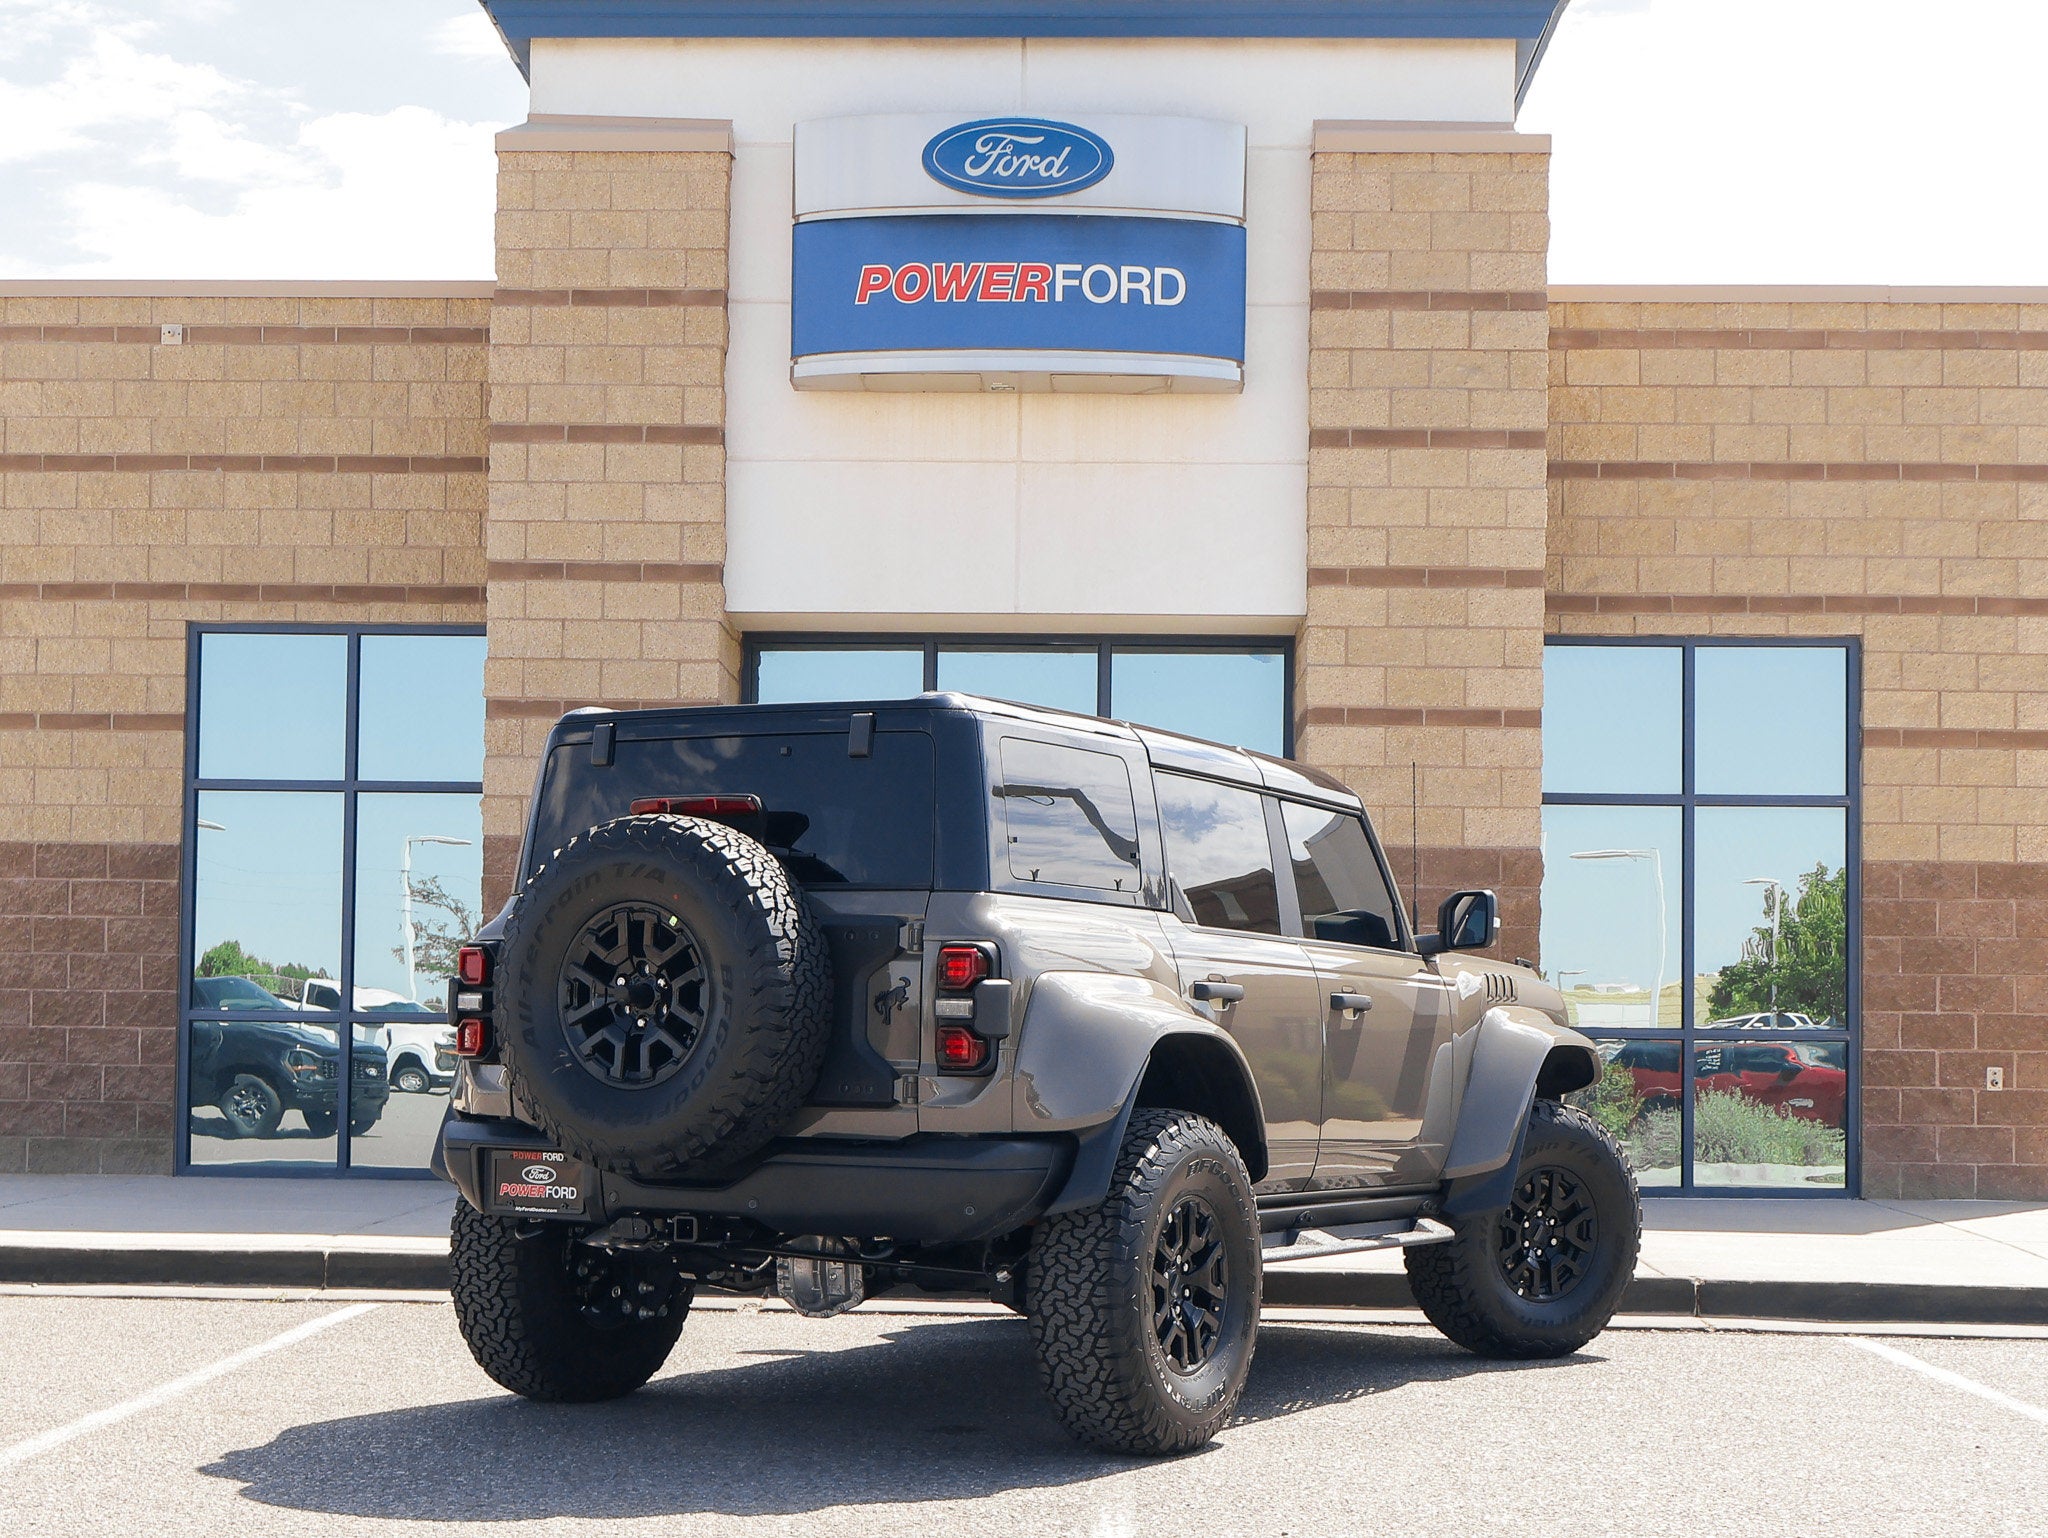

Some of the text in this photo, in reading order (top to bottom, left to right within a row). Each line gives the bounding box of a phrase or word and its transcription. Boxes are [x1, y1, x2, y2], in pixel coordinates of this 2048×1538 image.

[964, 133, 1072, 178] Ford
[855, 262, 1187, 306] POWERFORD
[512, 1151, 565, 1162] POWERFORD
[528, 1167, 549, 1180] Ford
[500, 1183, 578, 1199] POWERFORD
